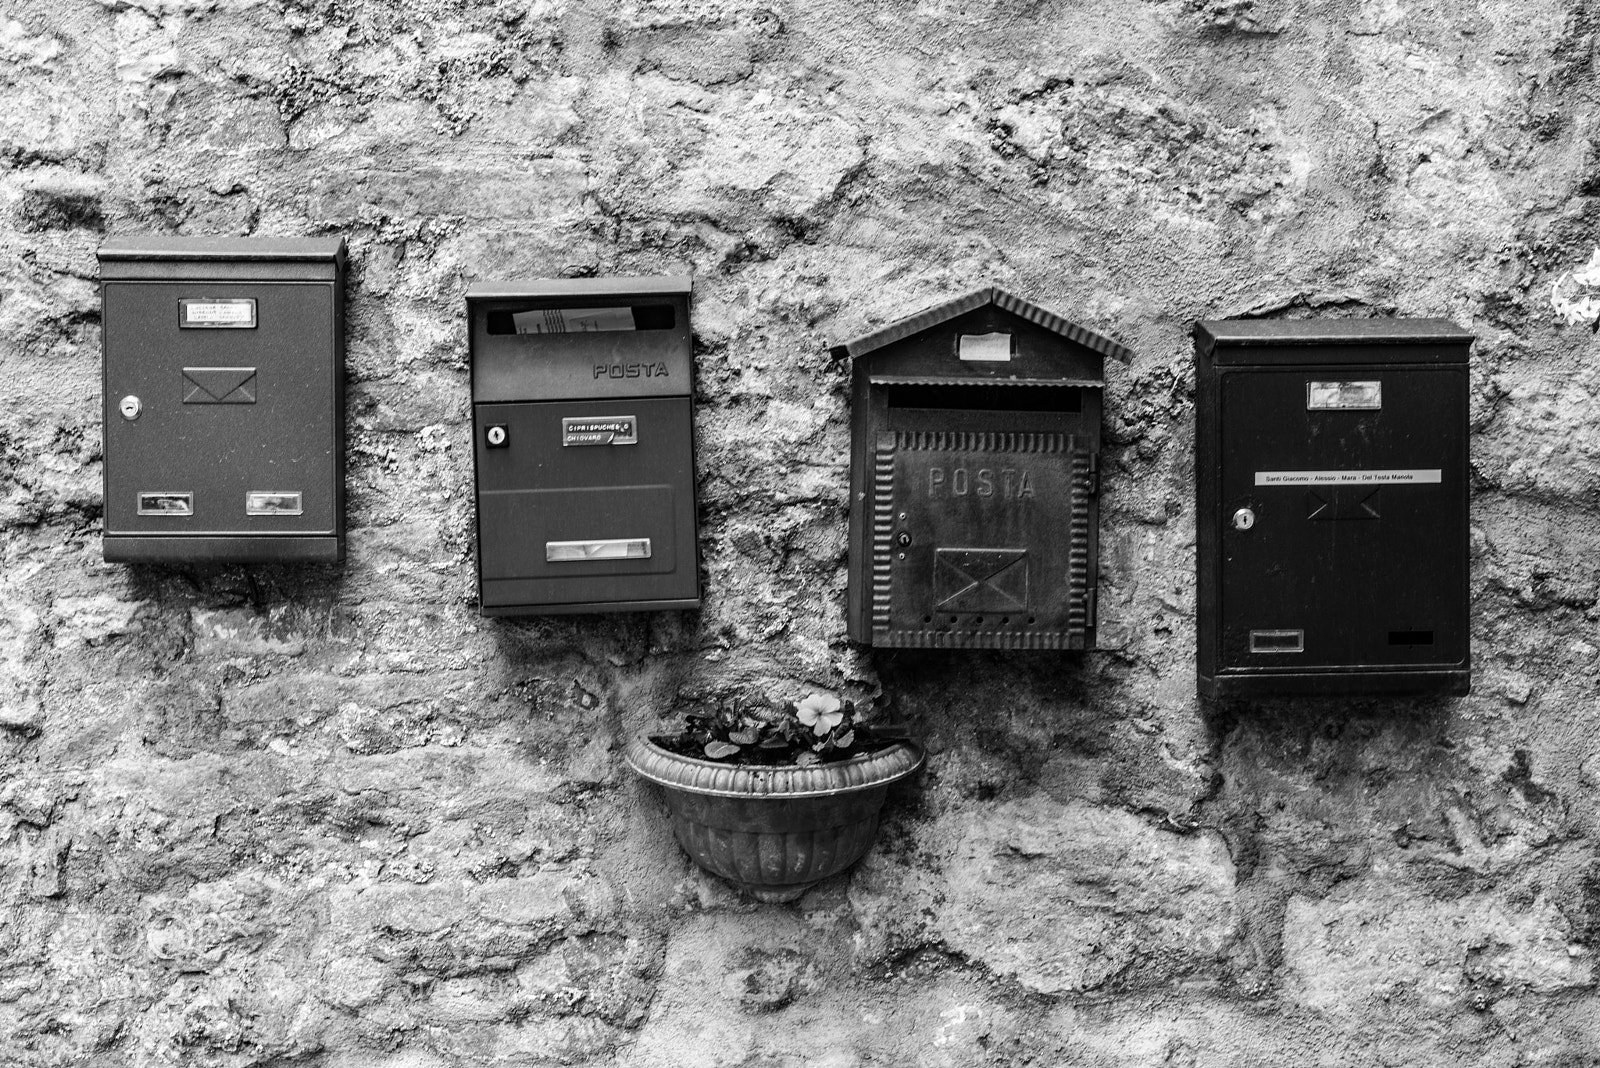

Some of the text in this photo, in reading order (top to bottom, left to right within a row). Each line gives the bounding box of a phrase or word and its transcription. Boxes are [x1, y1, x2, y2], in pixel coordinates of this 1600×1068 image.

[593, 362, 669, 379] POSTA
[928, 467, 1034, 499] POSTA
[1374, 473, 1390, 481] Testa
